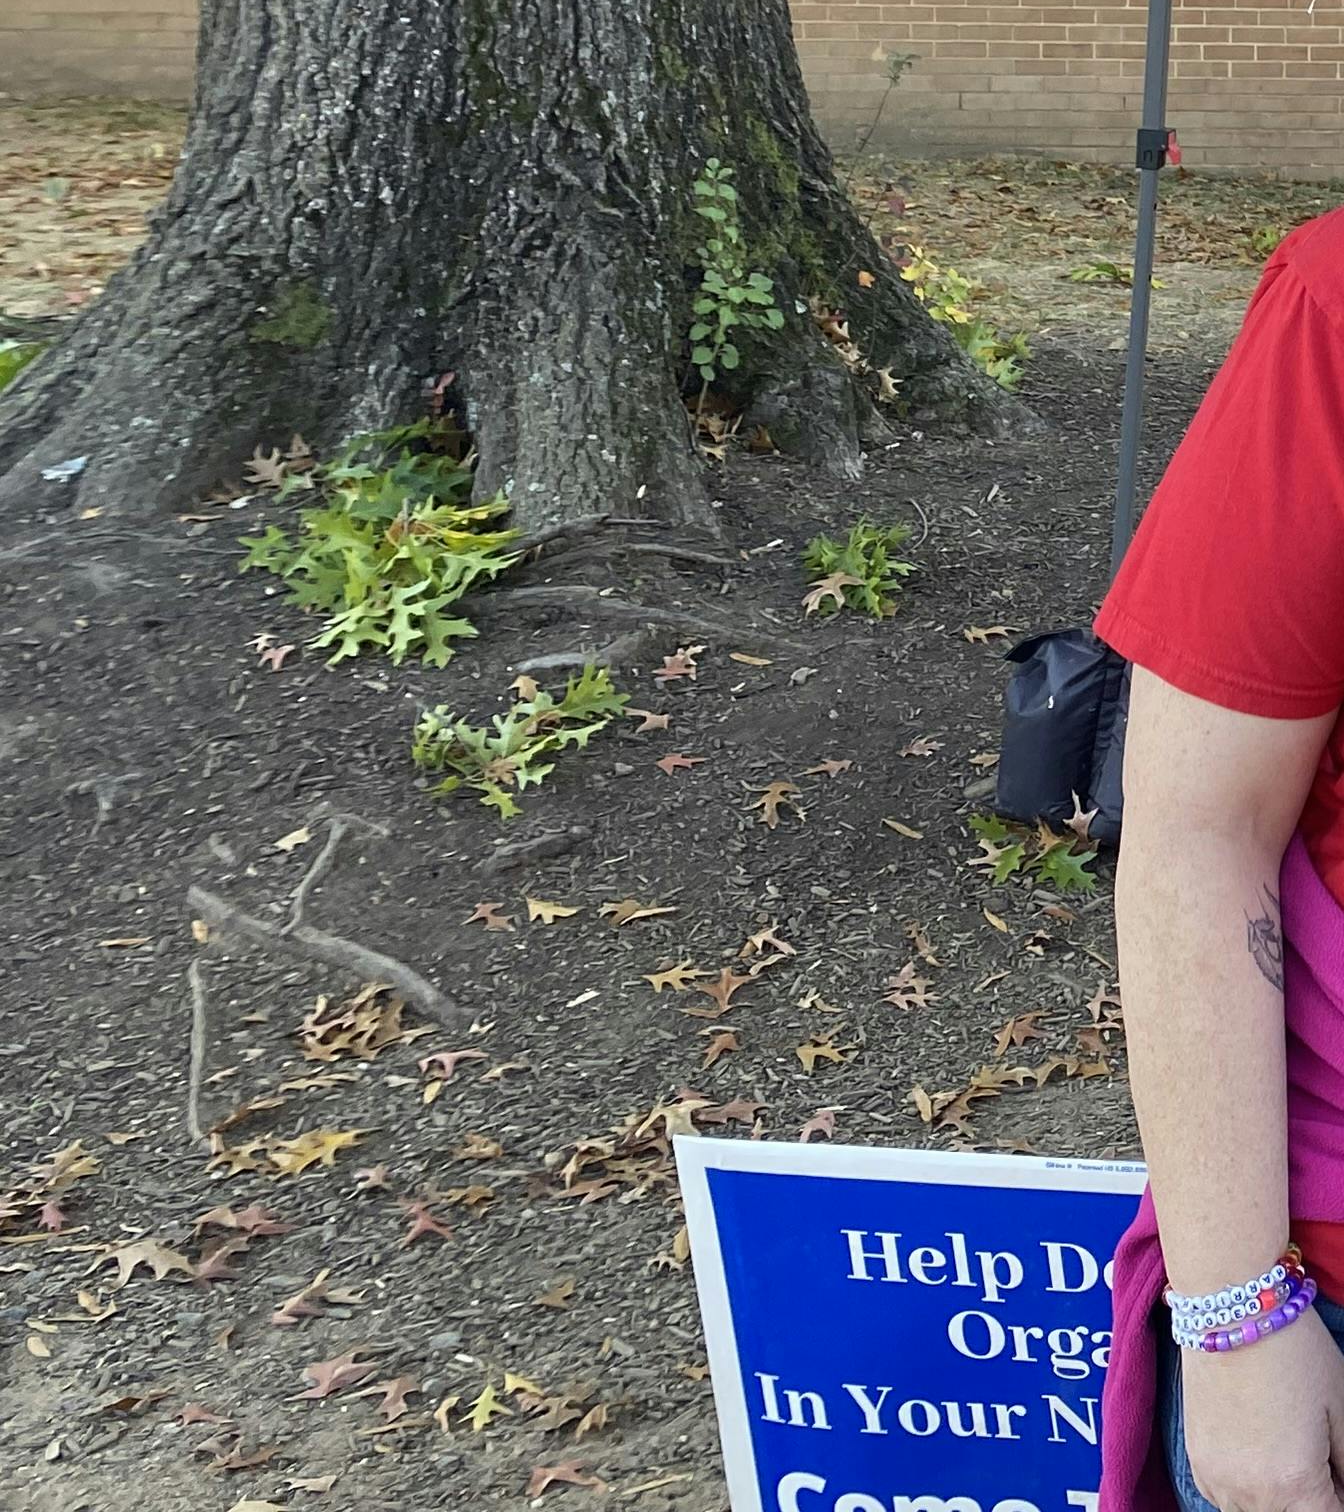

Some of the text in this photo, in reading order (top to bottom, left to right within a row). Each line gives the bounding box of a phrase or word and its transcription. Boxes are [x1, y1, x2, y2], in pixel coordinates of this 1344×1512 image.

[840, 1229, 1025, 1304] Help
[754, 1371, 833, 1431] In
[842, 1383, 1028, 1441] Your
